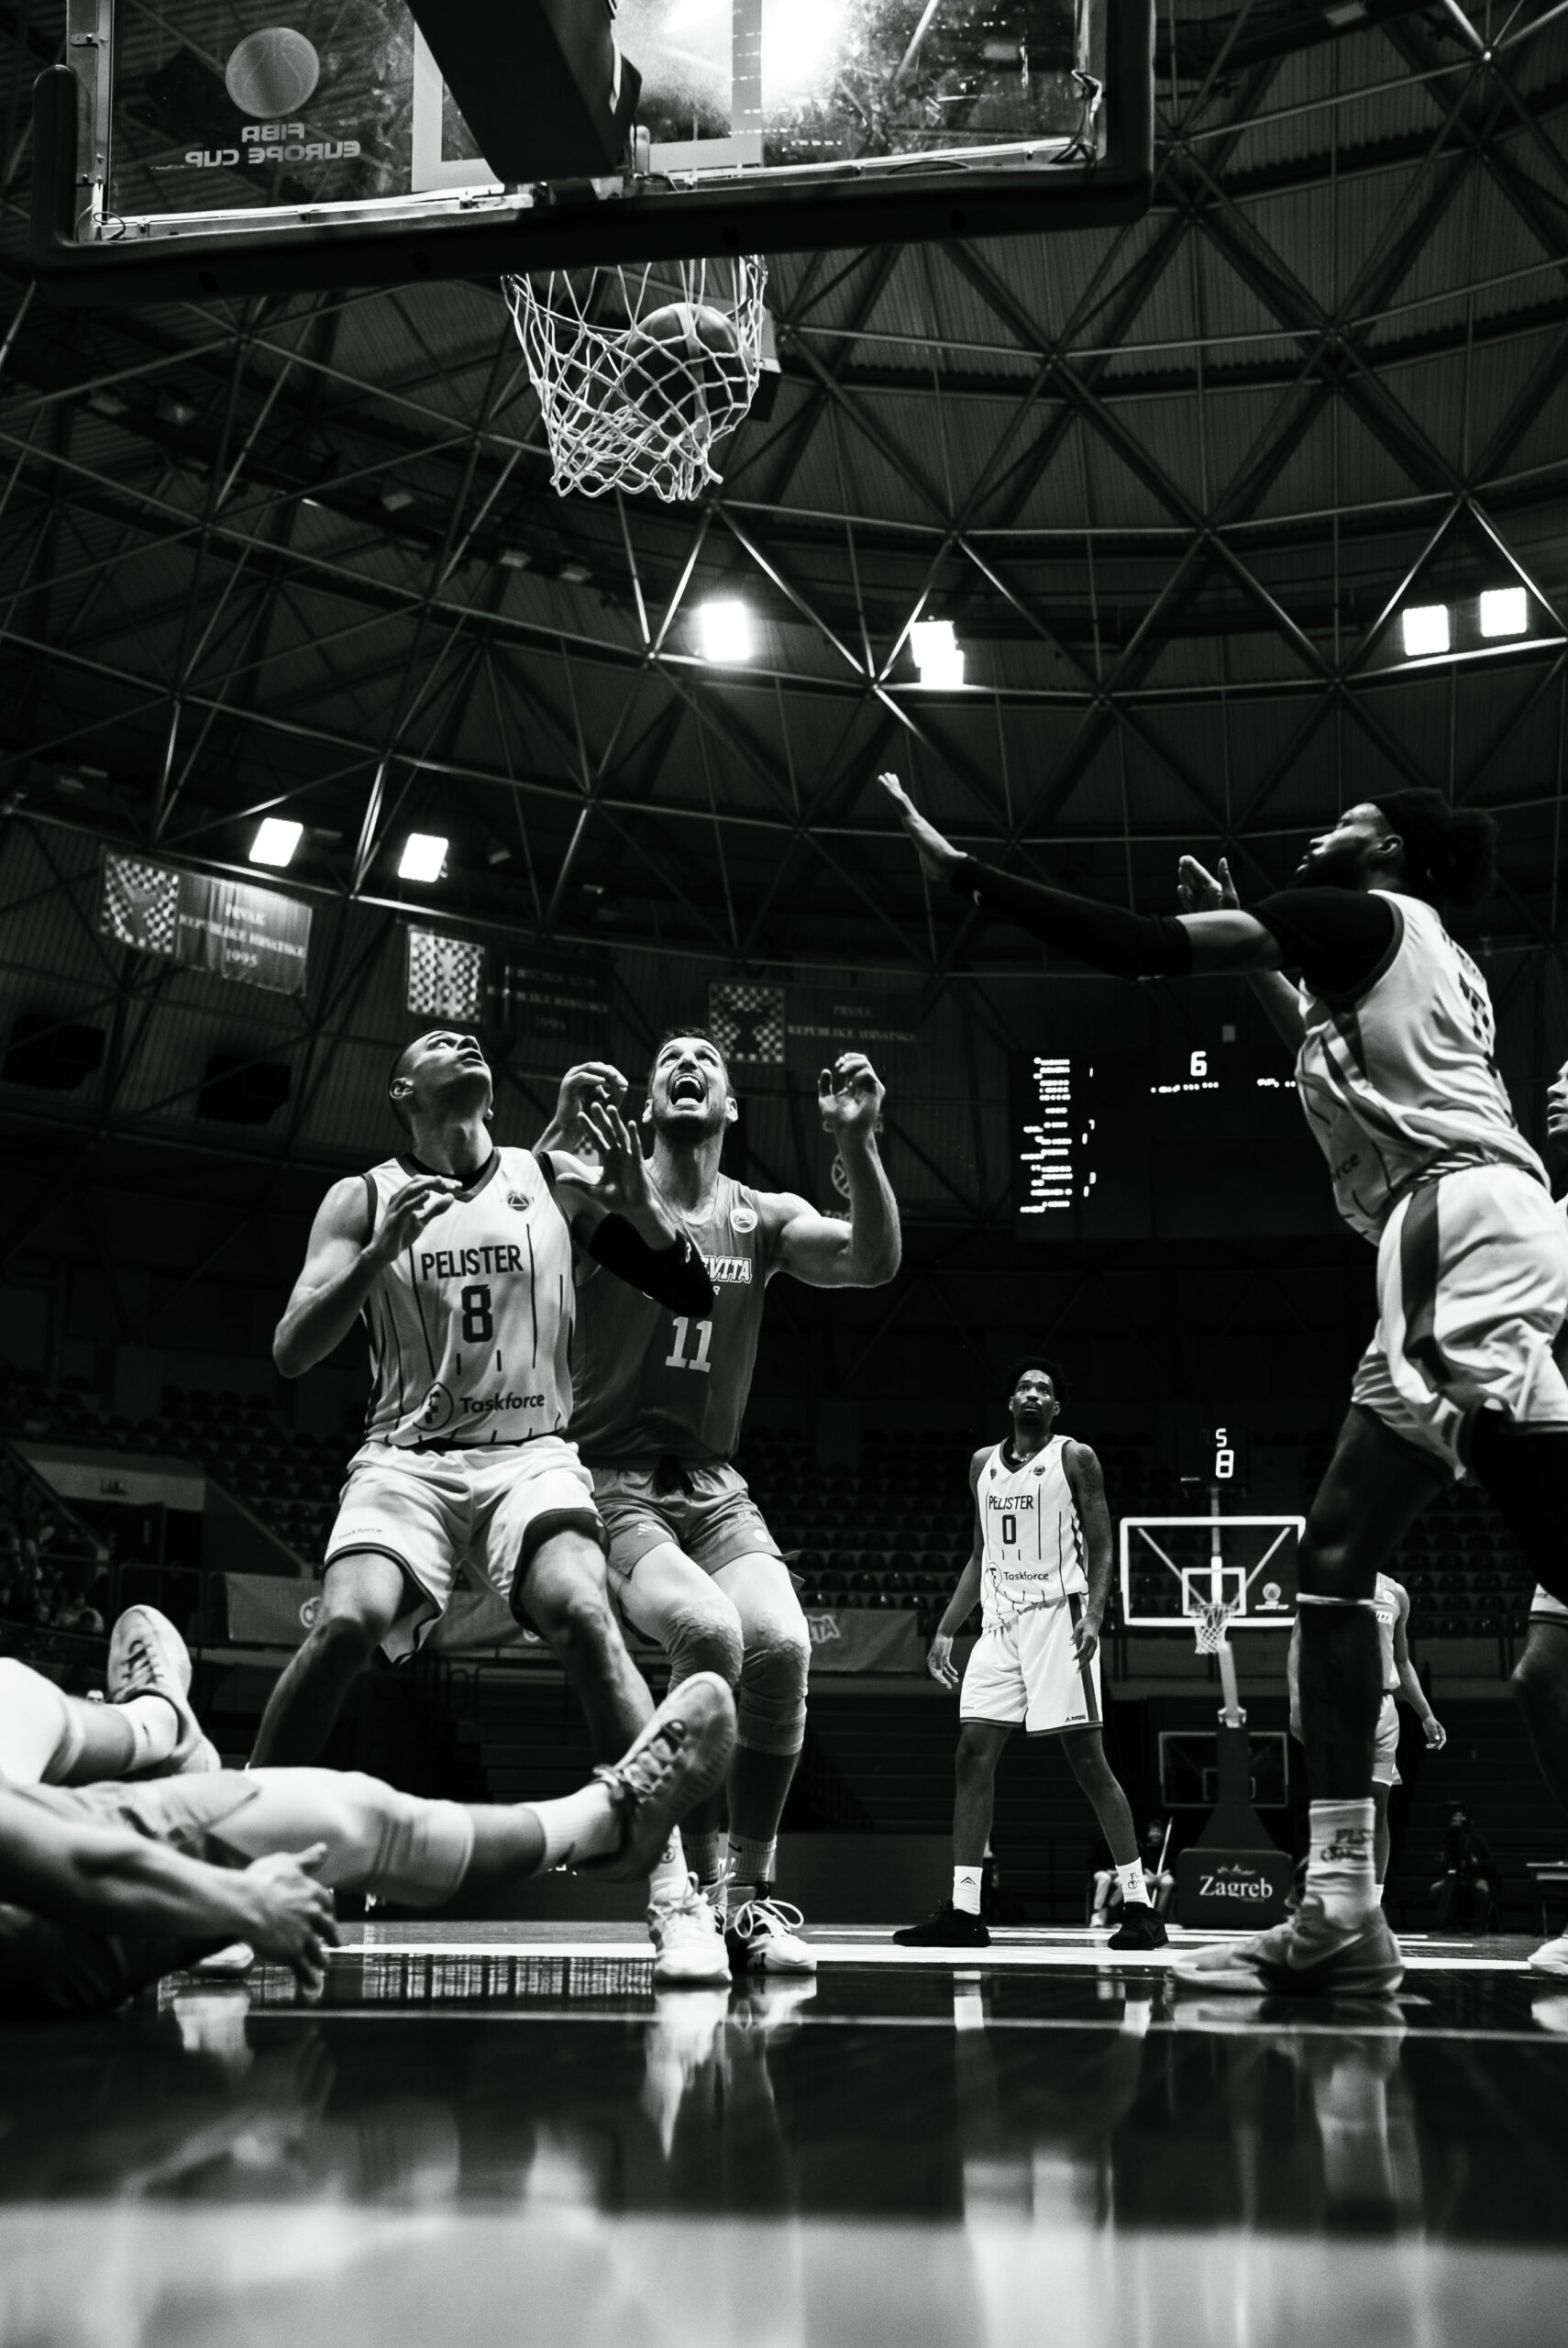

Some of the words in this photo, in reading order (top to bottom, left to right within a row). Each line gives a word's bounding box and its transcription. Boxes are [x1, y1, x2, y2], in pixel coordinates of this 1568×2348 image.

[1191, 1051, 1207, 1077] 6
[421, 1245, 524, 1281] PELISTER
[461, 1284, 493, 1344] 8
[665, 1316, 712, 1373] 11
[459, 1391, 545, 1414] Taskforce
[1215, 1450, 1234, 1478] 8
[988, 1495, 1034, 1510] PELISTER
[1002, 1514, 1017, 1545] 0
[1003, 1571, 1049, 1580] Taskforce
[1198, 1875, 1273, 1899] Zagreb
